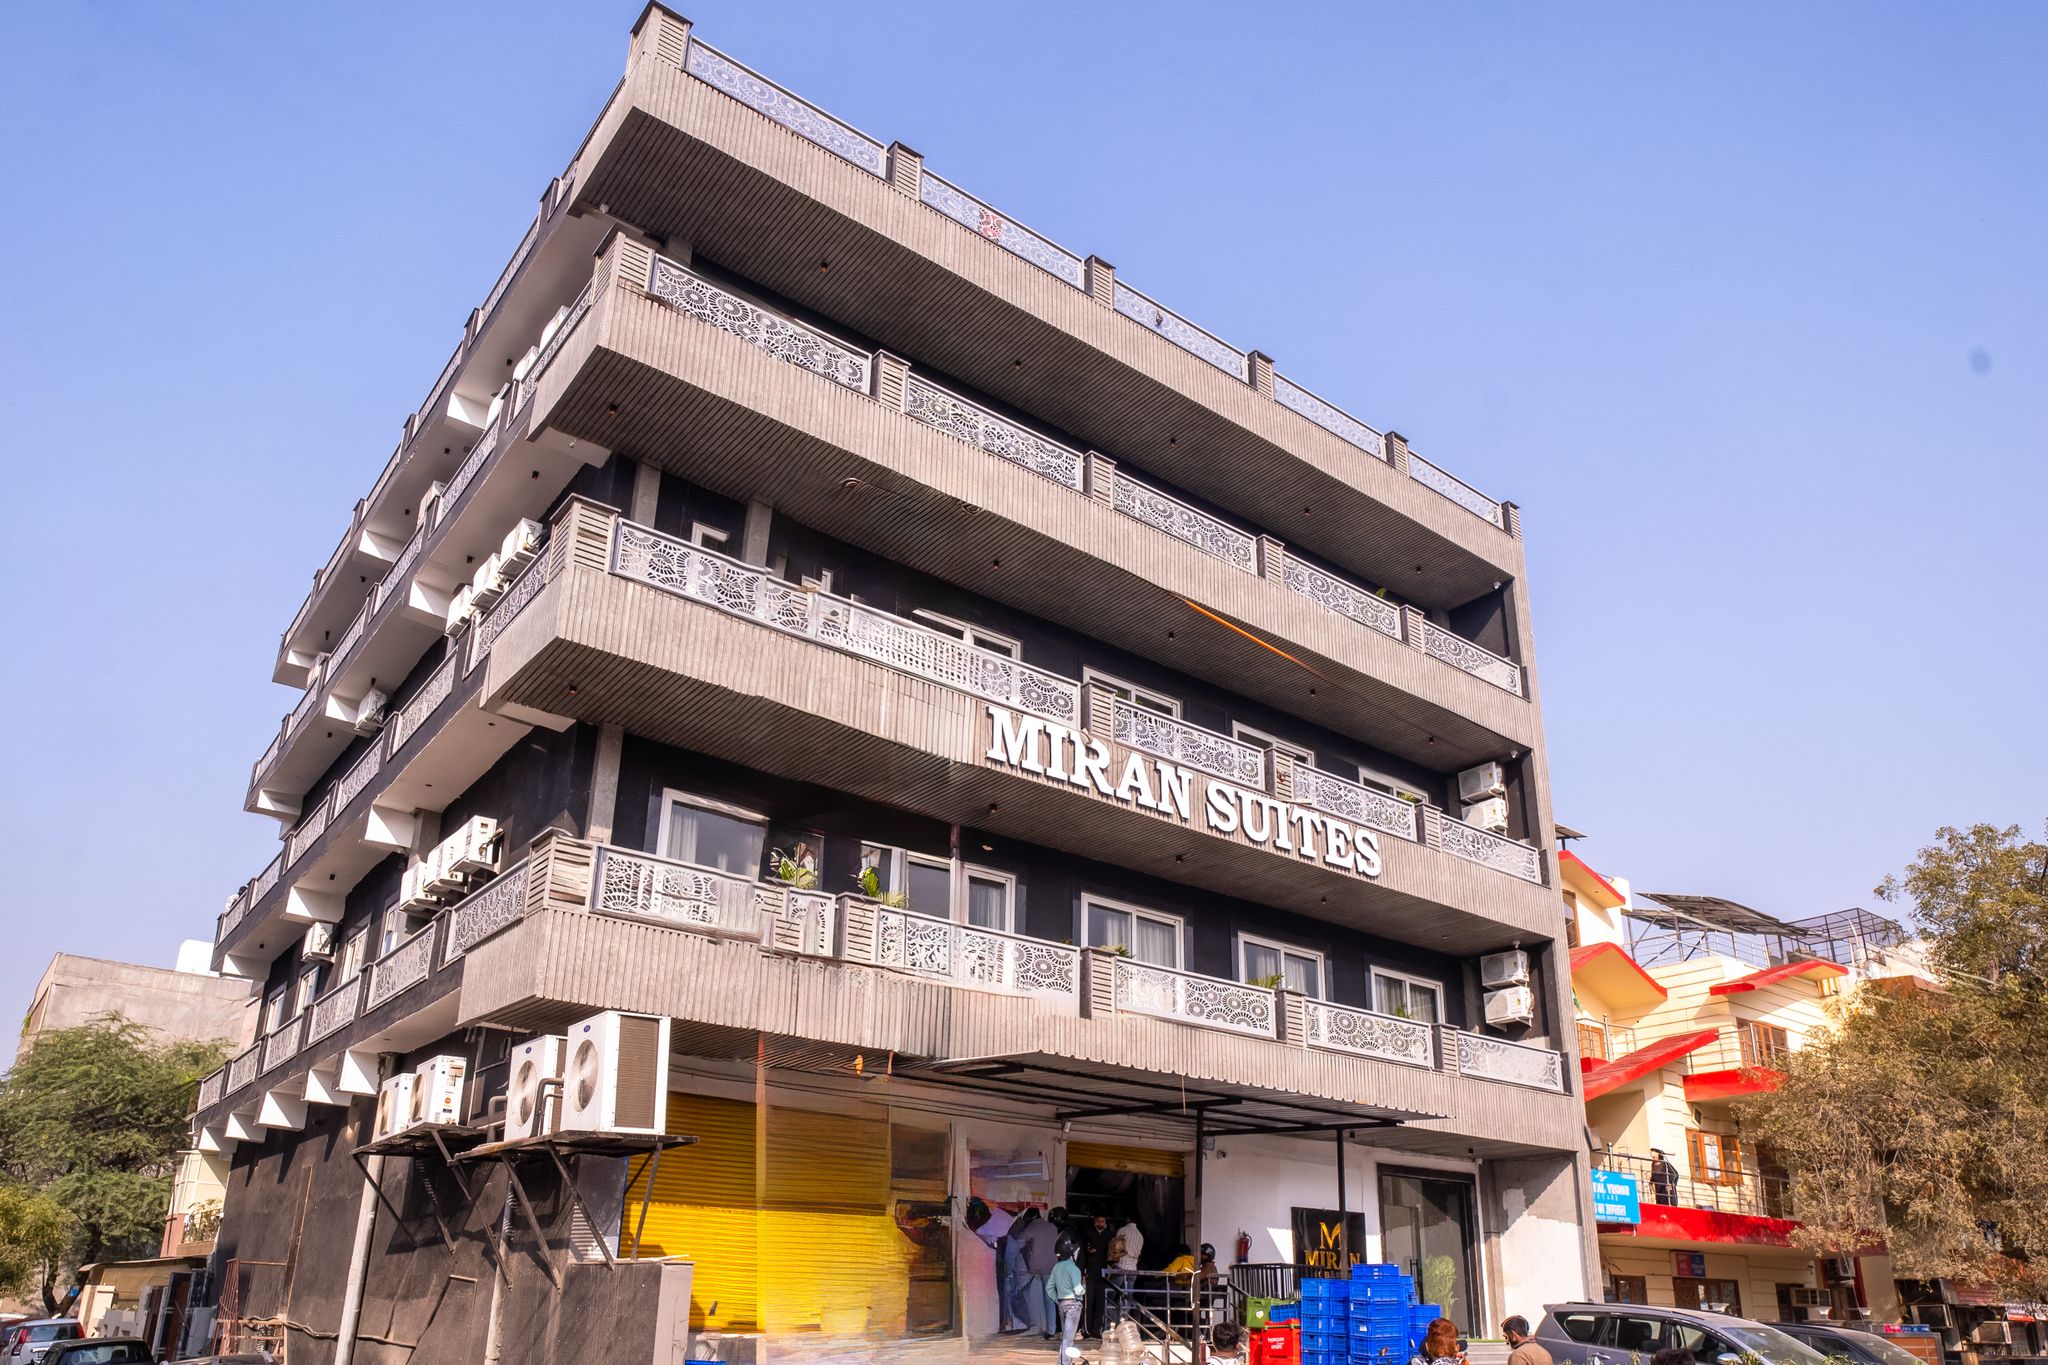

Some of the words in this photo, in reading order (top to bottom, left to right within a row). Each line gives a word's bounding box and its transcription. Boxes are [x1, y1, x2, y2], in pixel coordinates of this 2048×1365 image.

[985, 705, 1193, 822] MIRAN
[1206, 780, 1382, 877] SUITES
[1304, 1249, 1361, 1271] MIRN
